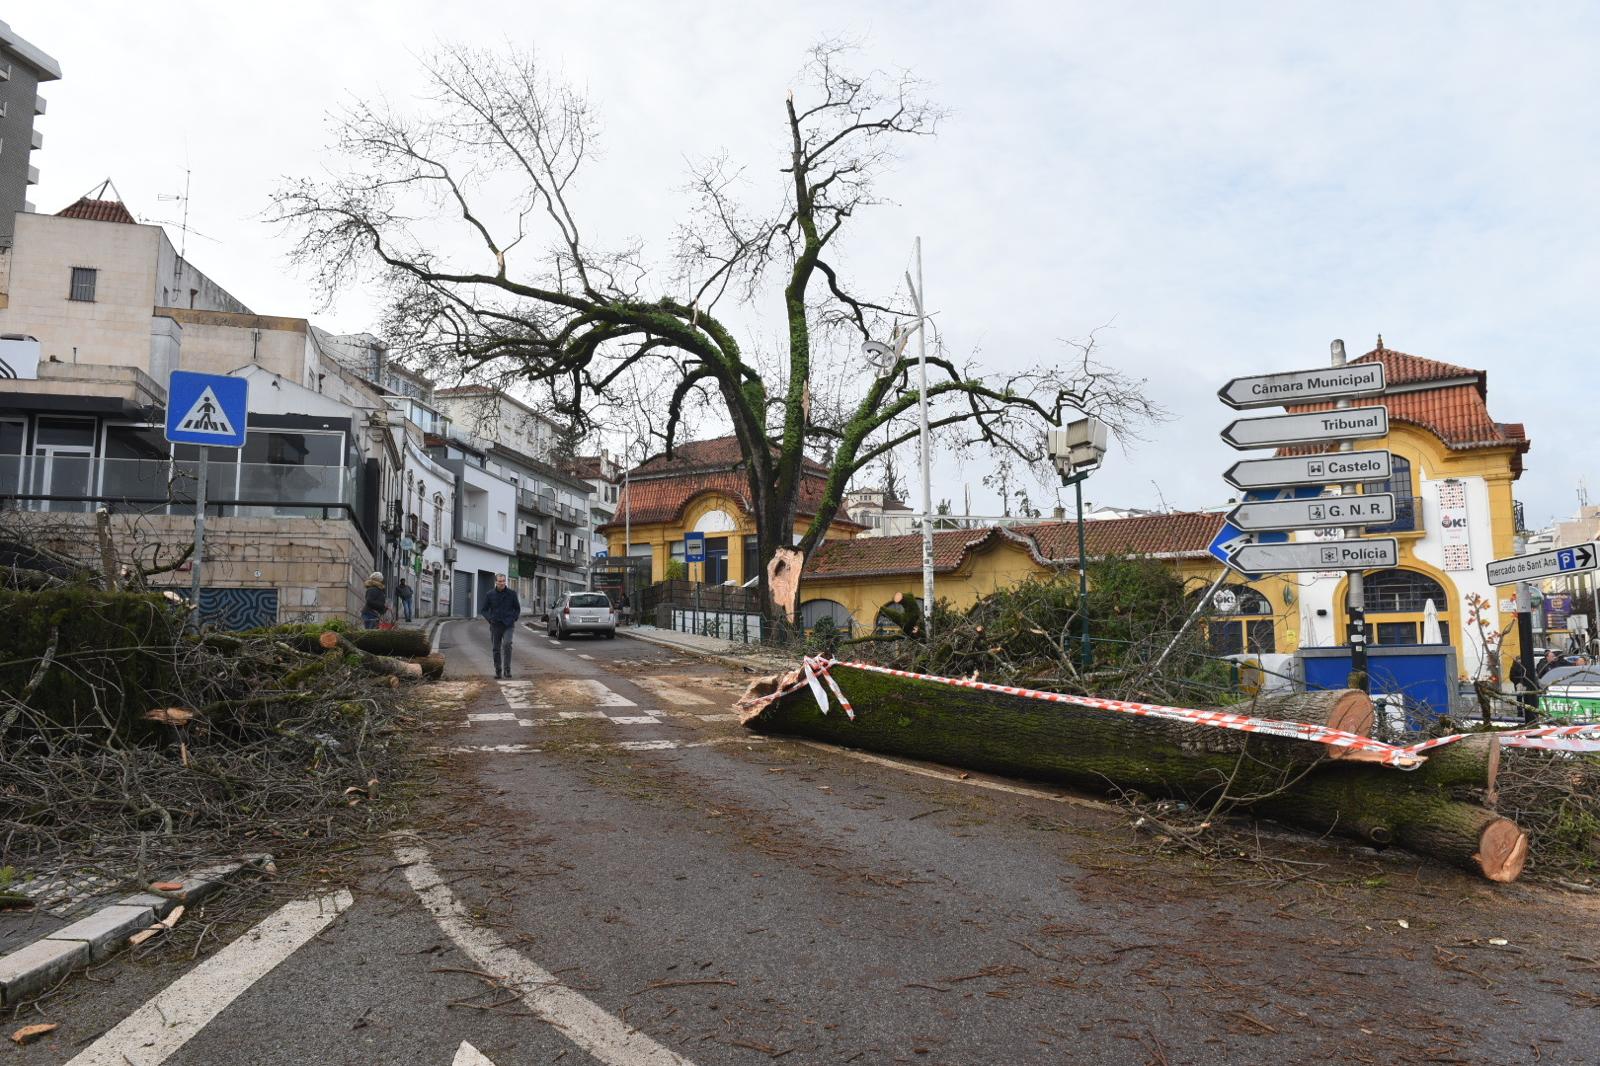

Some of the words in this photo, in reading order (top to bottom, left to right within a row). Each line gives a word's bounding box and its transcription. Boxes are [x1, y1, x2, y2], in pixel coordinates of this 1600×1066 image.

[1252, 382, 1303, 395] Câmara
[1307, 372, 1375, 389] Municipal
[1321, 416, 1378, 430] Tribunal
[1328, 460, 1381, 473] Castelo
[1342, 547, 1387, 560] Polícia
[1489, 564, 1516, 577] mercado
[1517, 562, 1526, 572] de
